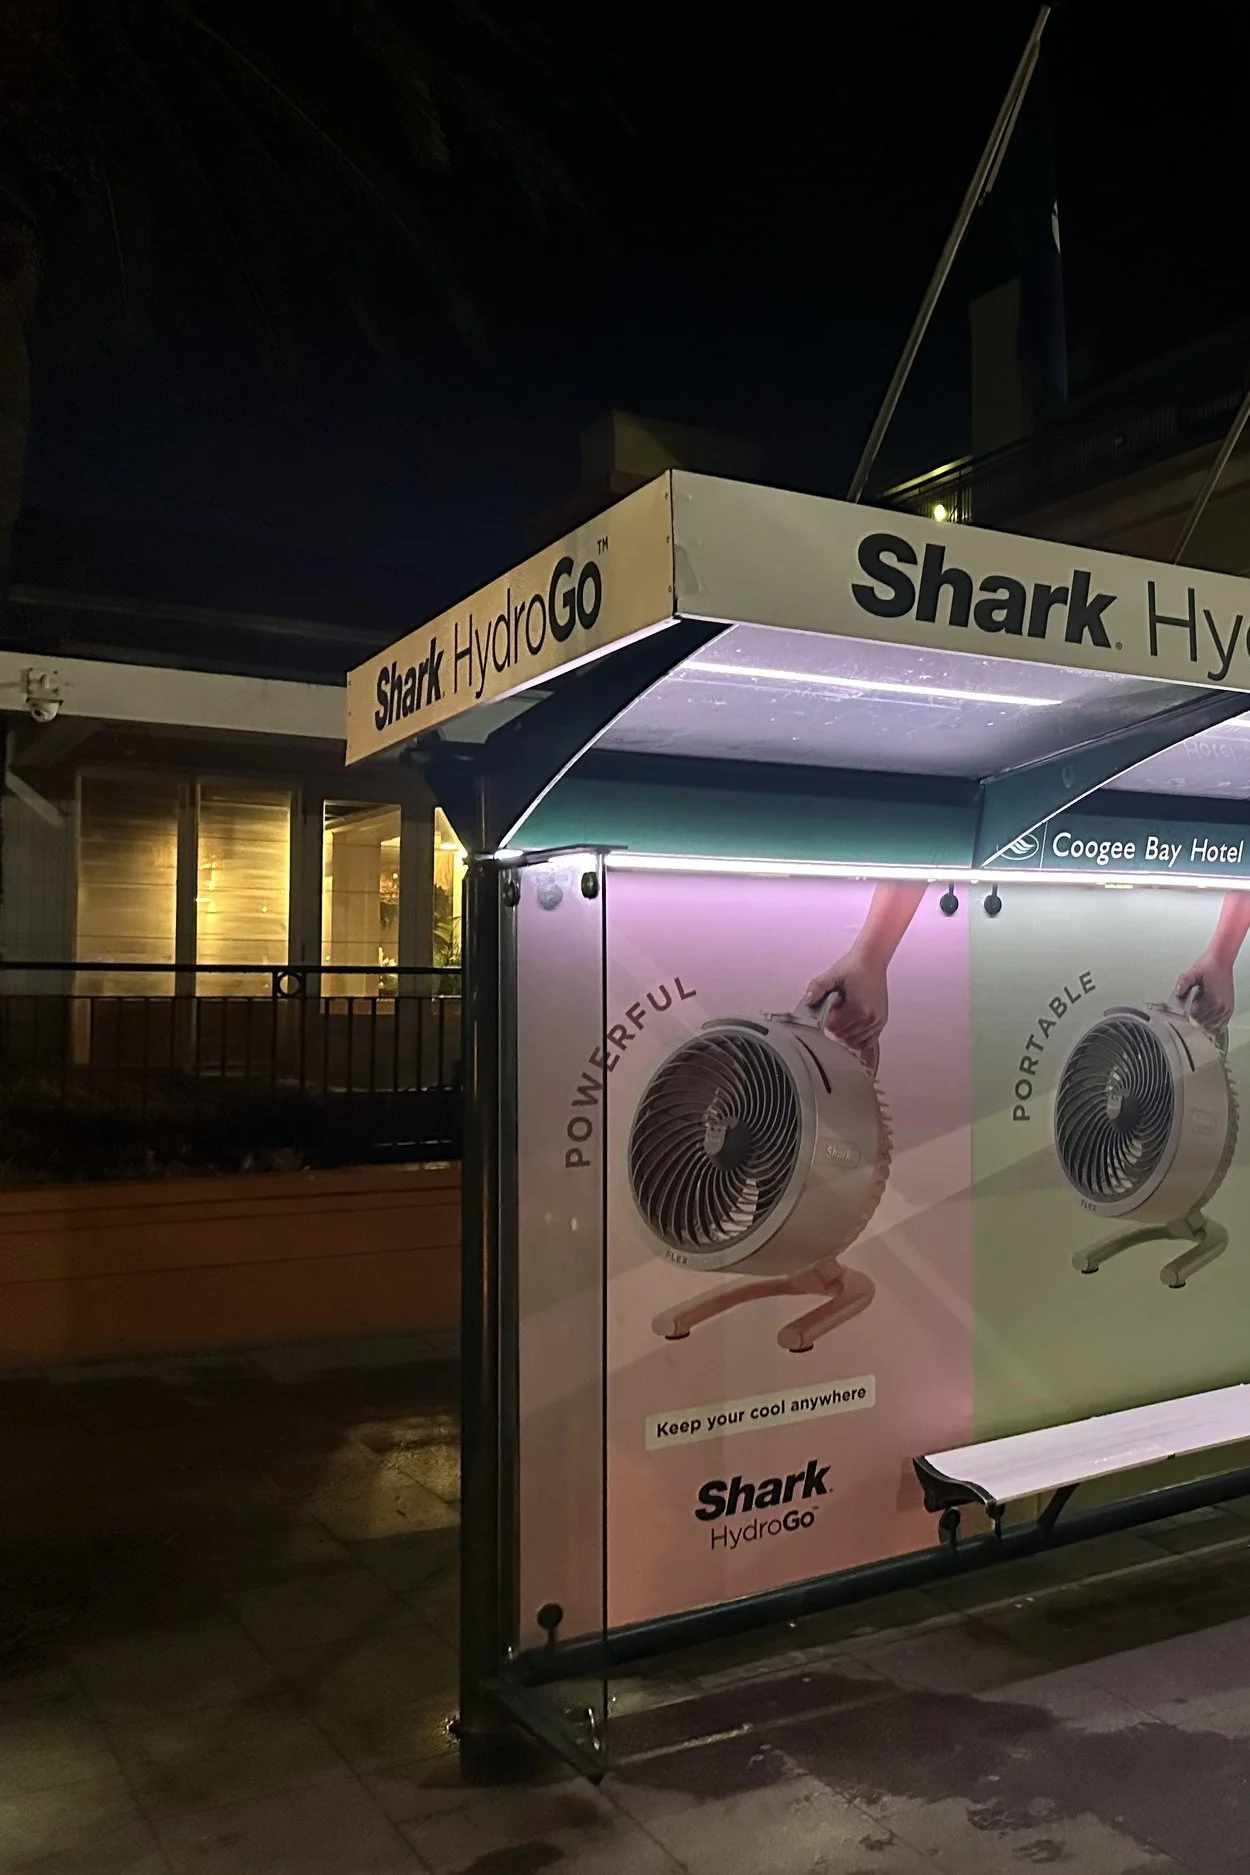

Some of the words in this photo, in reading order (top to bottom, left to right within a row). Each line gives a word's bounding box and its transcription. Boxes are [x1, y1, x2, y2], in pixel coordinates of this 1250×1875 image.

[1052, 832, 1136, 866] Coogee
[1145, 836, 1183, 868] Bay
[1190, 838, 1244, 863] Hotel
[565, 976, 697, 1168] POWERFUL
[1012, 970, 1097, 1122] PORTABLE
[656, 1418, 702, 1438] Keep
[707, 1408, 745, 1431] your
[750, 1399, 786, 1419] cool
[790, 1384, 867, 1412] anywhere
[694, 1460, 832, 1521] Shark
